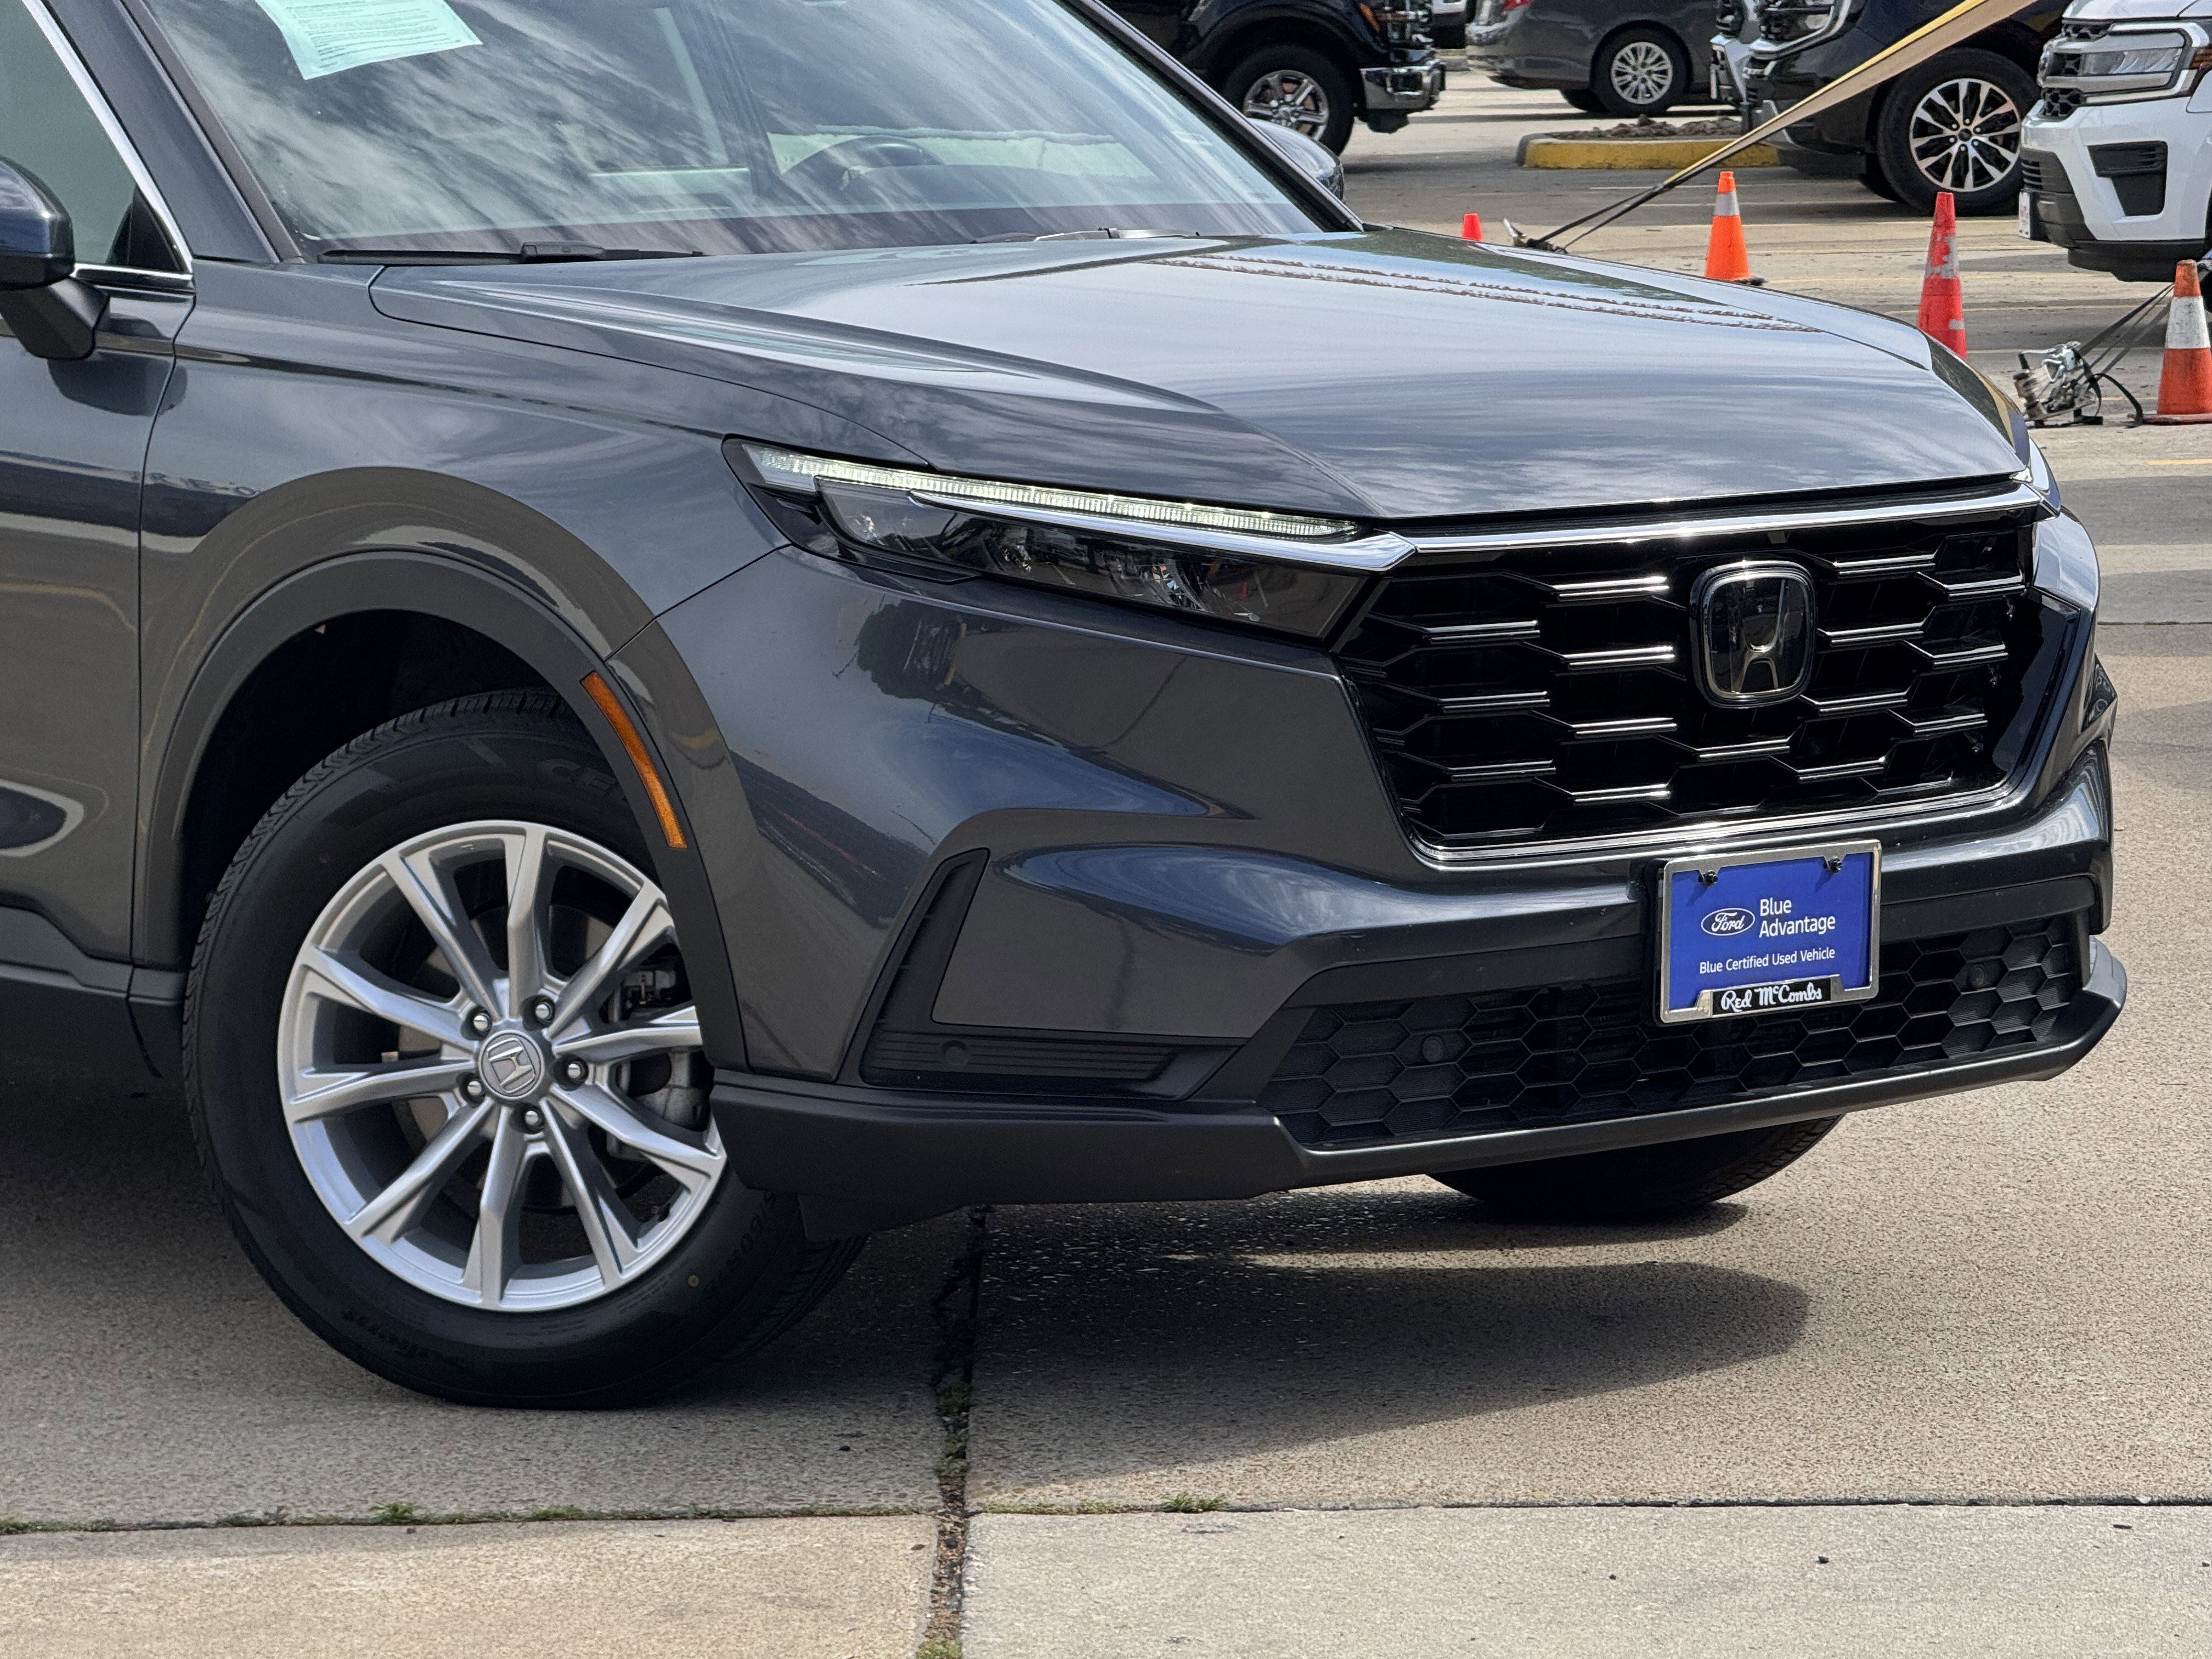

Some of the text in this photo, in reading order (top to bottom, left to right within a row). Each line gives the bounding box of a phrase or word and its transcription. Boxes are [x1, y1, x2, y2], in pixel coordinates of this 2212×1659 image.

[1759, 897, 1792, 917] Blue
[1711, 911, 1746, 932] Ford
[1758, 915, 1836, 938] Advantage
[1699, 946, 1836, 974] Blue Certified Used Vehicle
[1720, 981, 1823, 1013] Red McCombs
